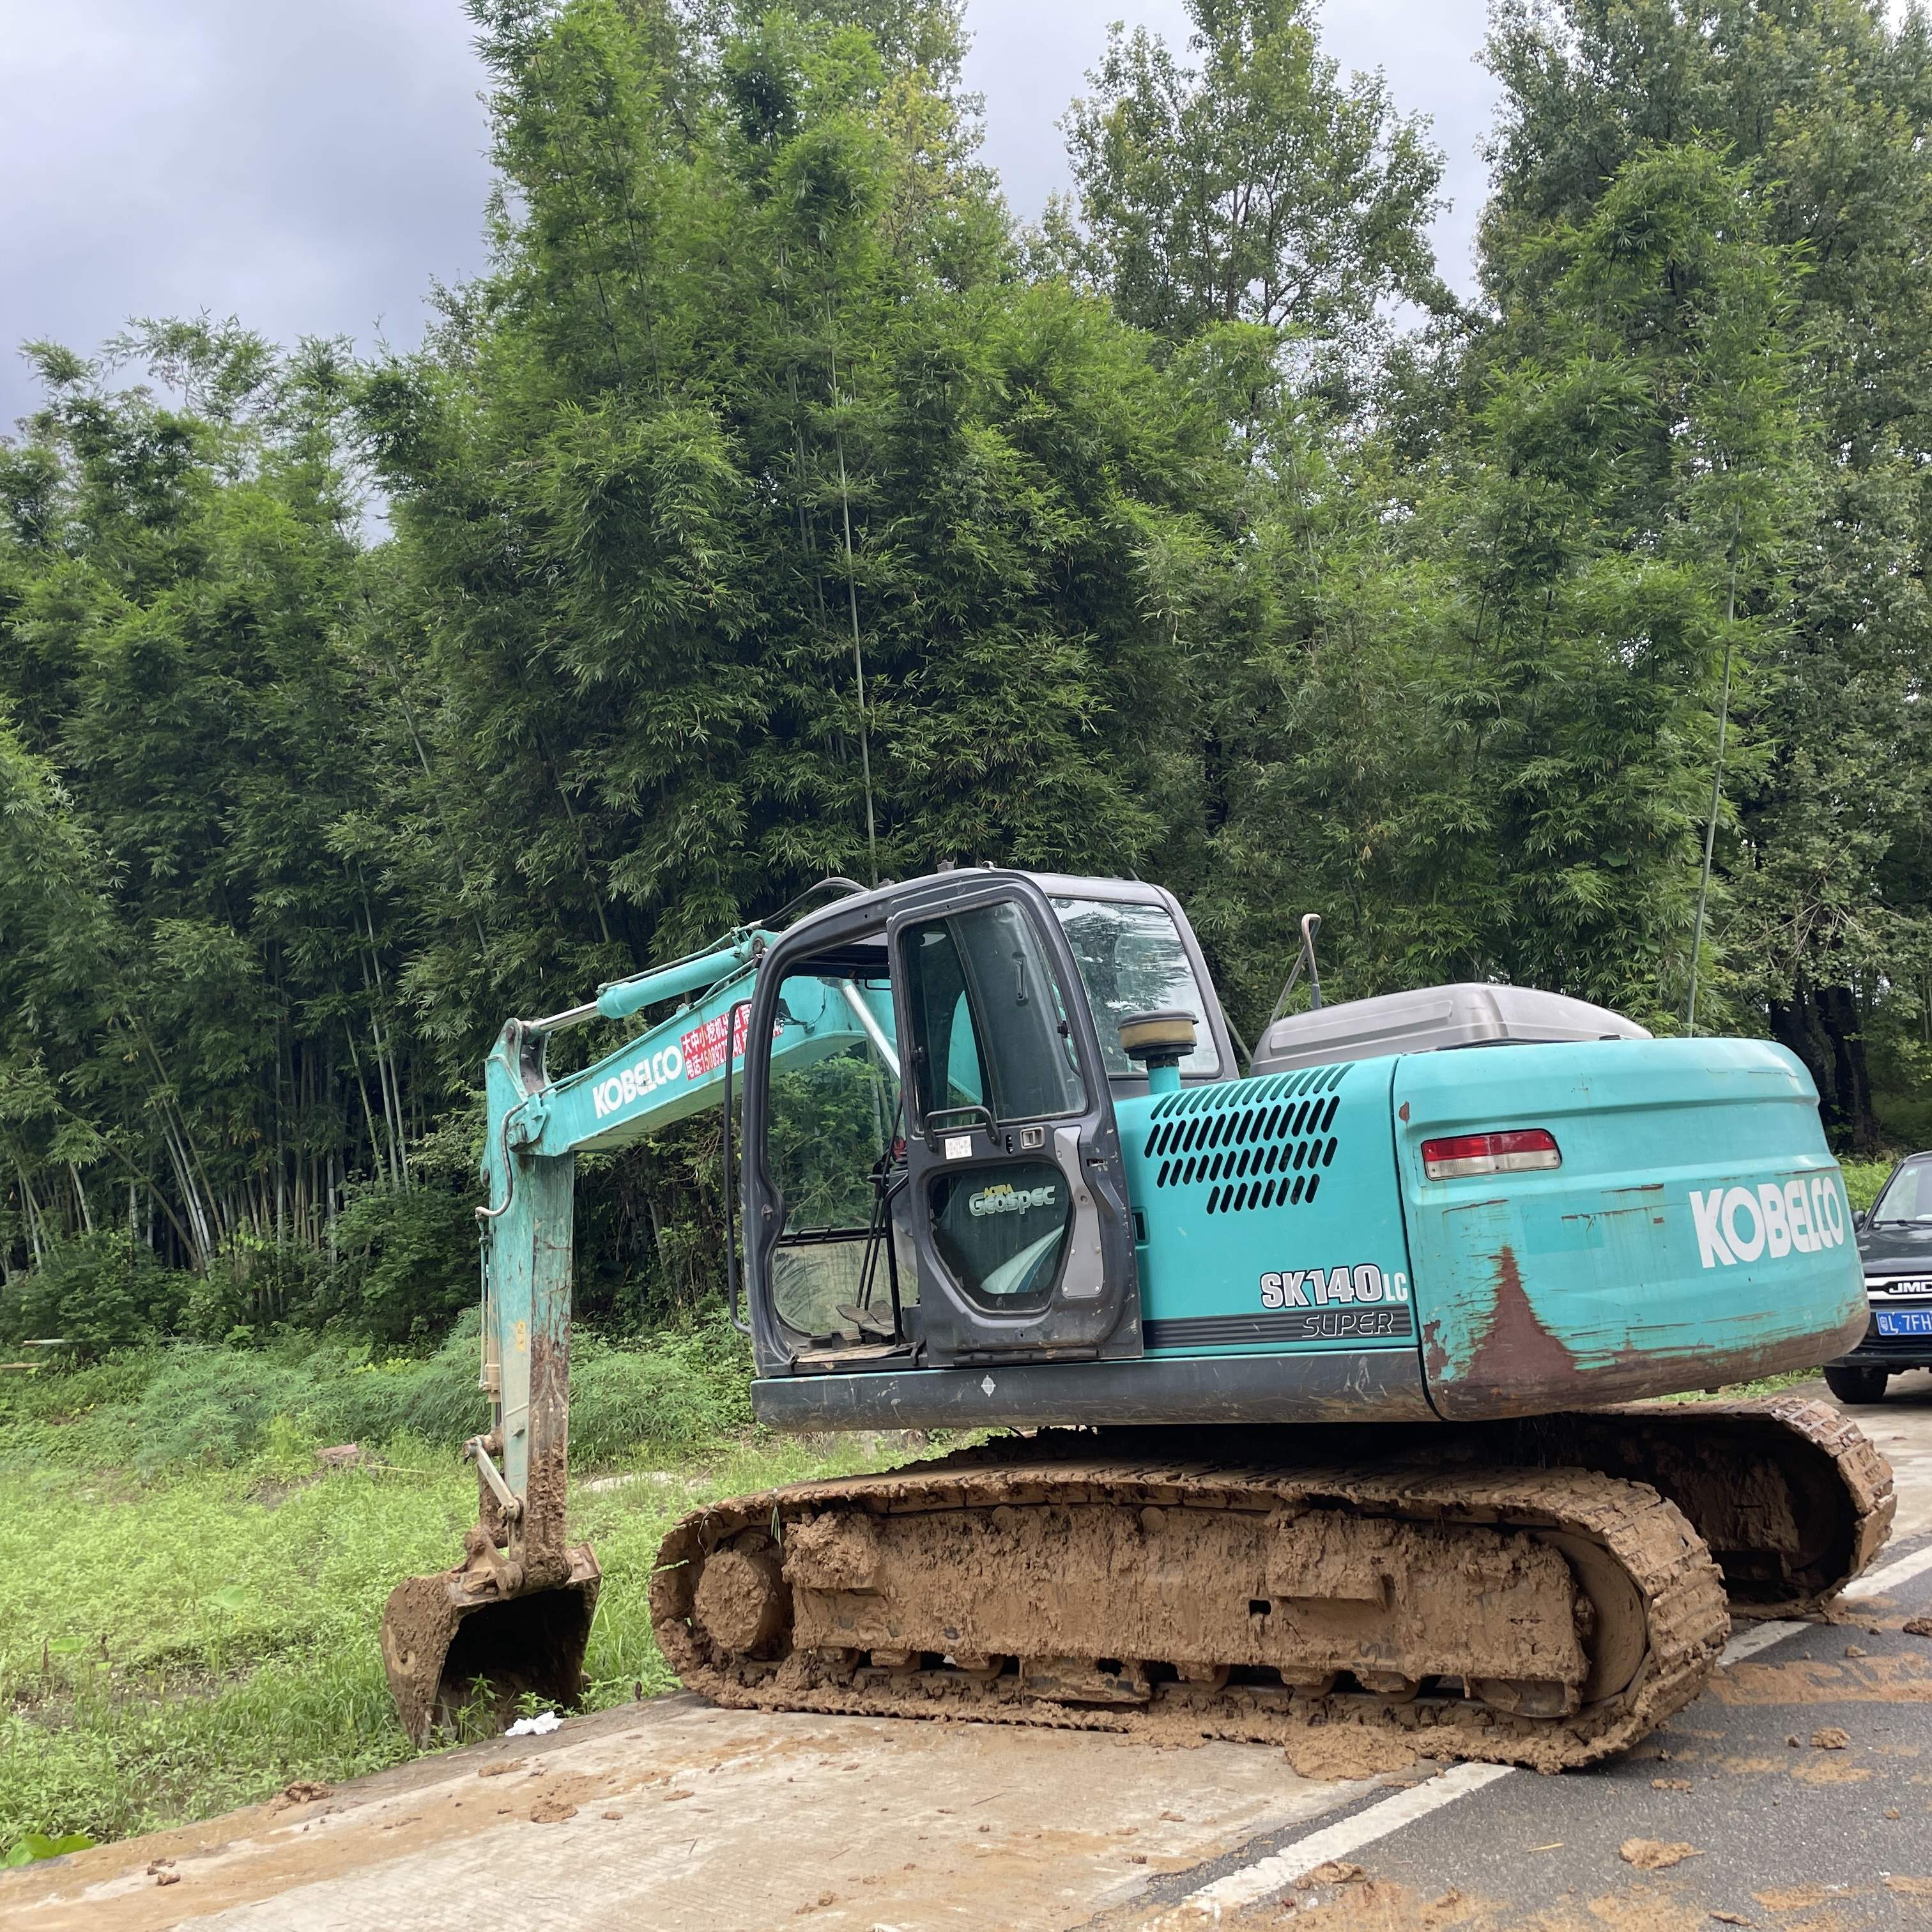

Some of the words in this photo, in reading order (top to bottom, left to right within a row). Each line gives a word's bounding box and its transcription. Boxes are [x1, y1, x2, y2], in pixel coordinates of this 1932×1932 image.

[592, 1045, 683, 1119] KOBELCO
[1689, 1176, 1844, 1269] KOBELCO
[1301, 1311, 1393, 1338] SUPER
